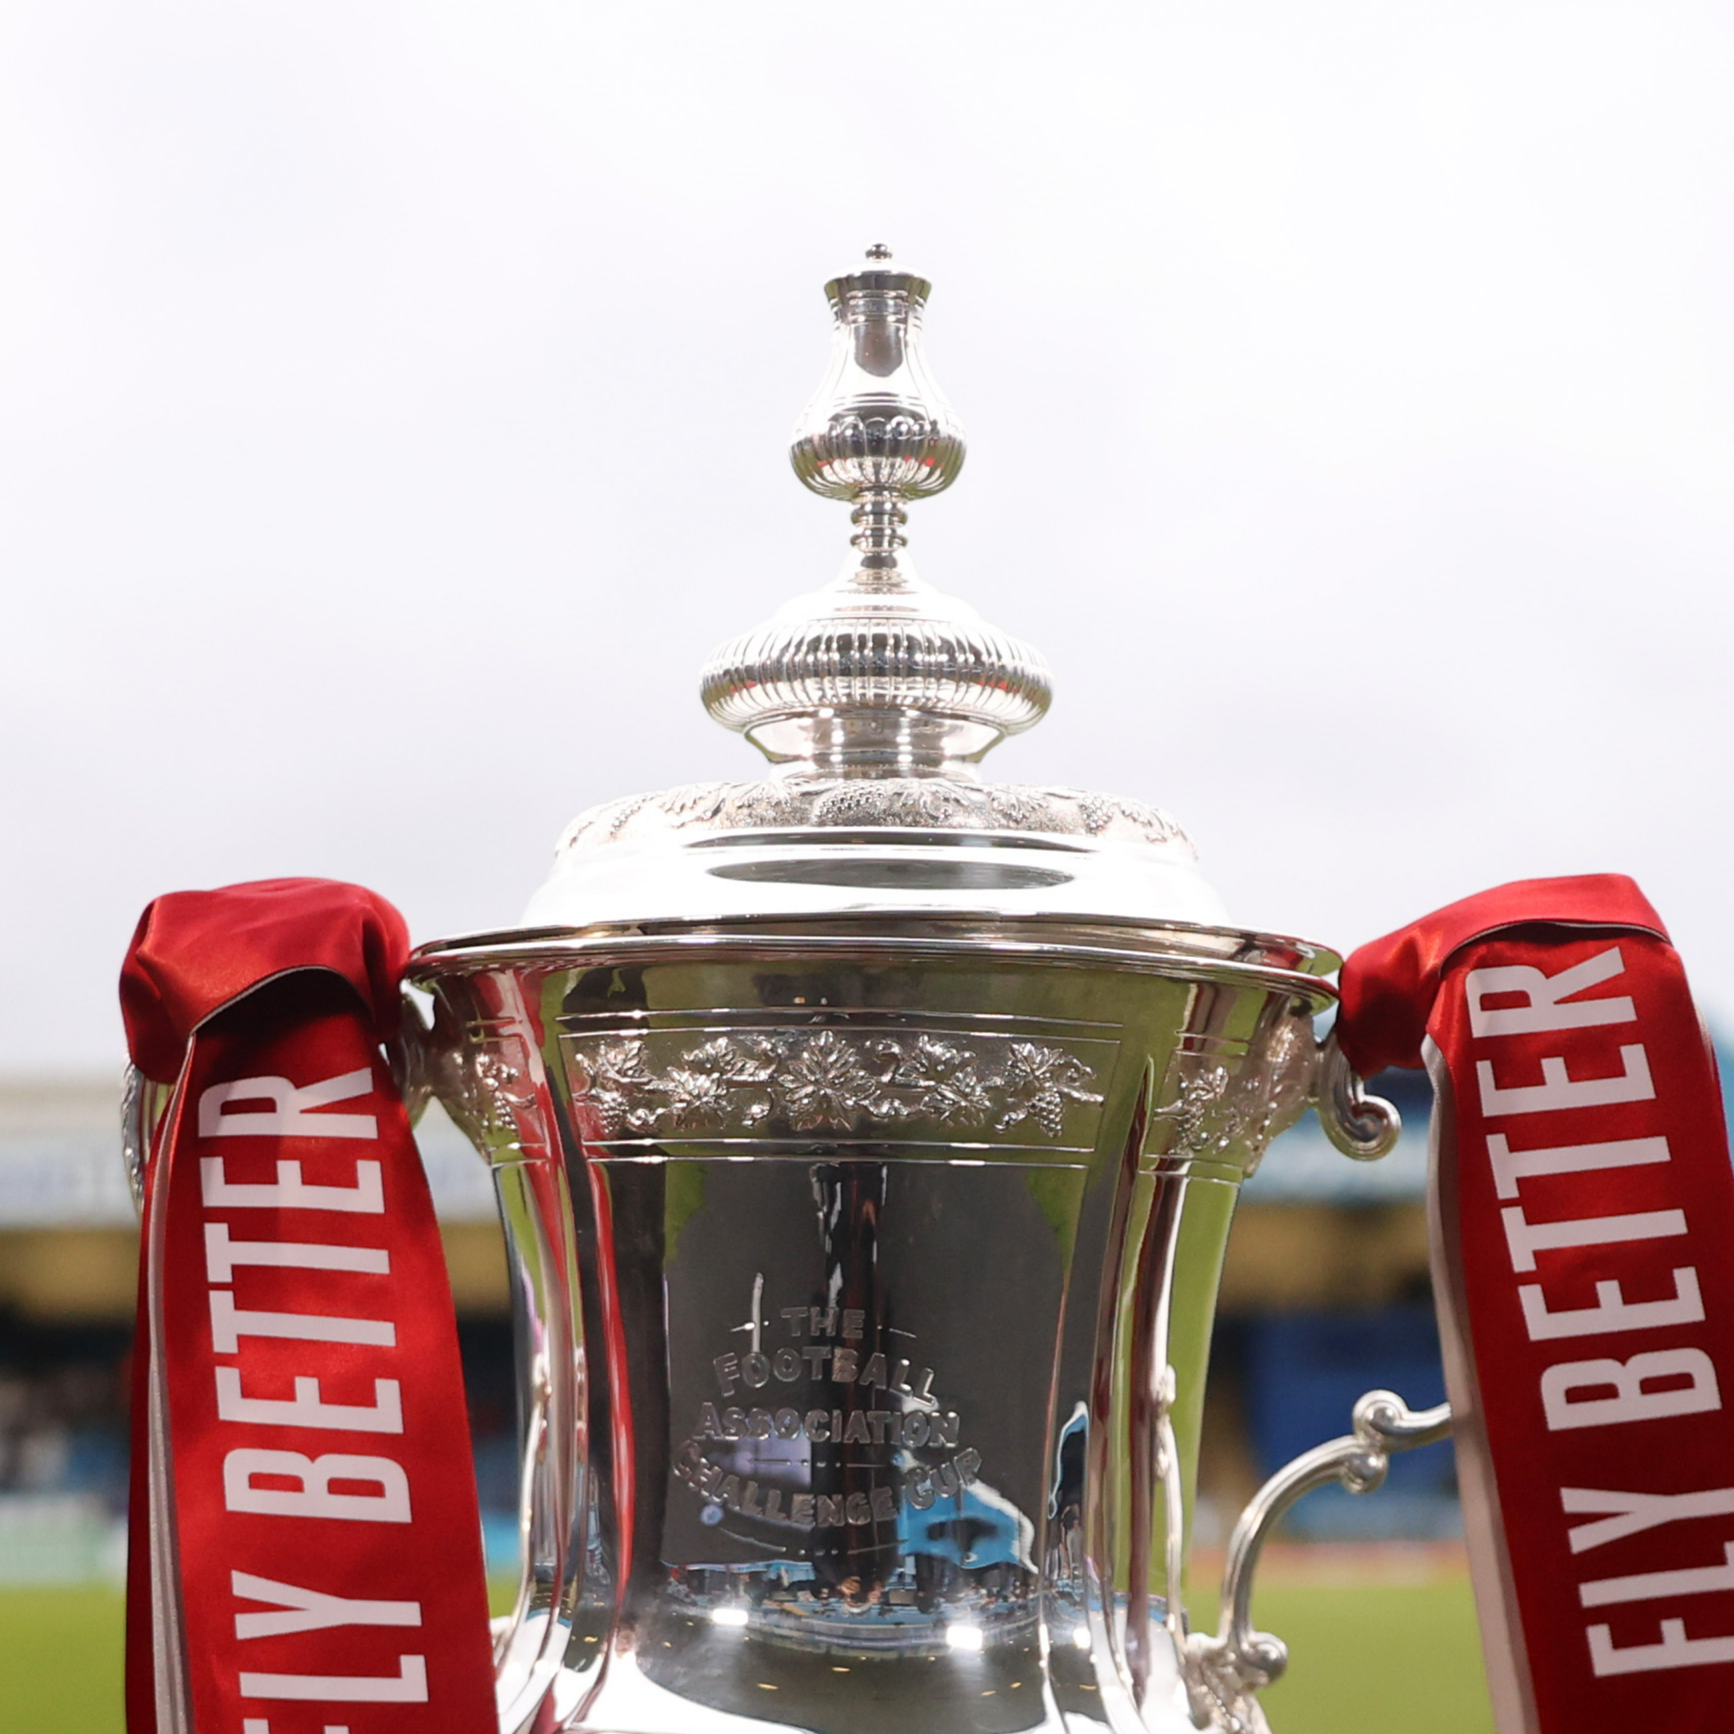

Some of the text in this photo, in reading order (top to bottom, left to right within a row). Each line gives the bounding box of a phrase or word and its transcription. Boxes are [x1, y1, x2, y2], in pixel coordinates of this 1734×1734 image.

[1465, 945, 1722, 1431] BETTER
[198, 1067, 412, 1523] BETTER
[780, 1306, 866, 1340] THE
[713, 1346, 935, 1407] FOOTBALL
[692, 1402, 961, 1449] ASSOCIATION
[672, 1438, 983, 1528] CHALLENGE CUP
